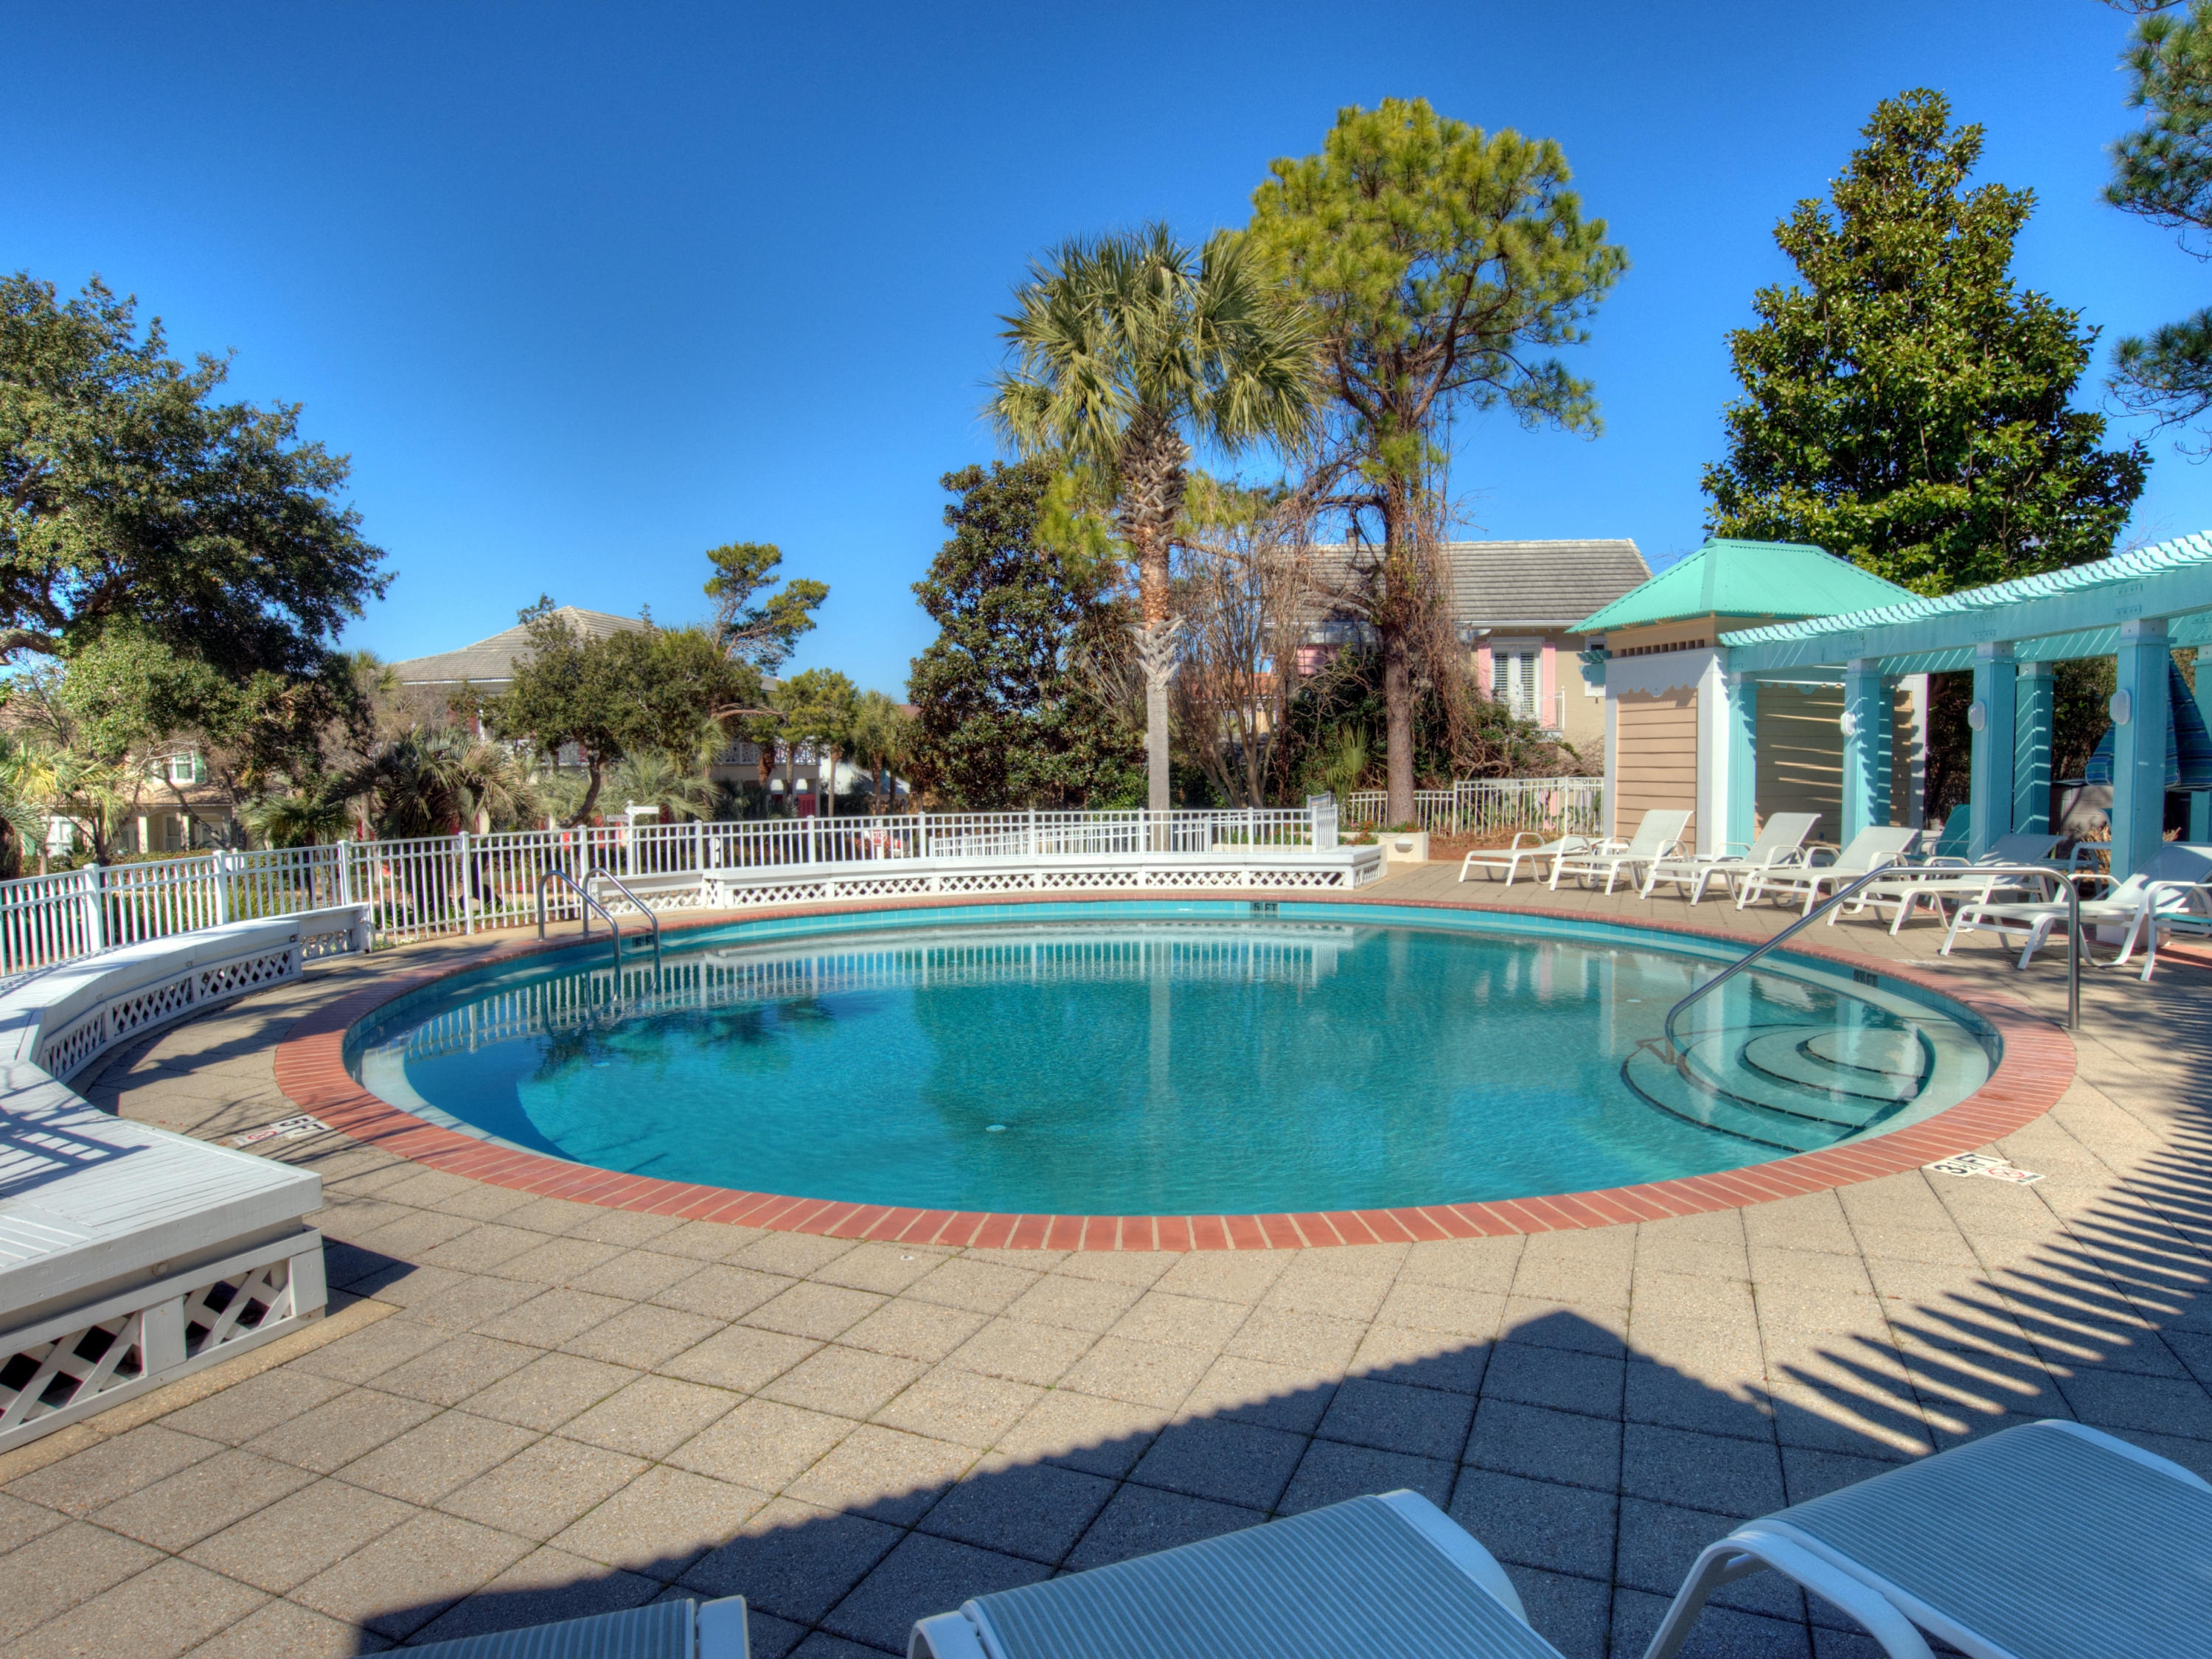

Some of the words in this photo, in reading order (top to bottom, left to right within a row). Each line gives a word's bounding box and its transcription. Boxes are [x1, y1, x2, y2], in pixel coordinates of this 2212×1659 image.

[1253, 902, 1260, 911] 5
[1265, 903, 1278, 911] FT
[279, 1117, 310, 1127] 5
[1954, 1153, 1999, 1166] FT
